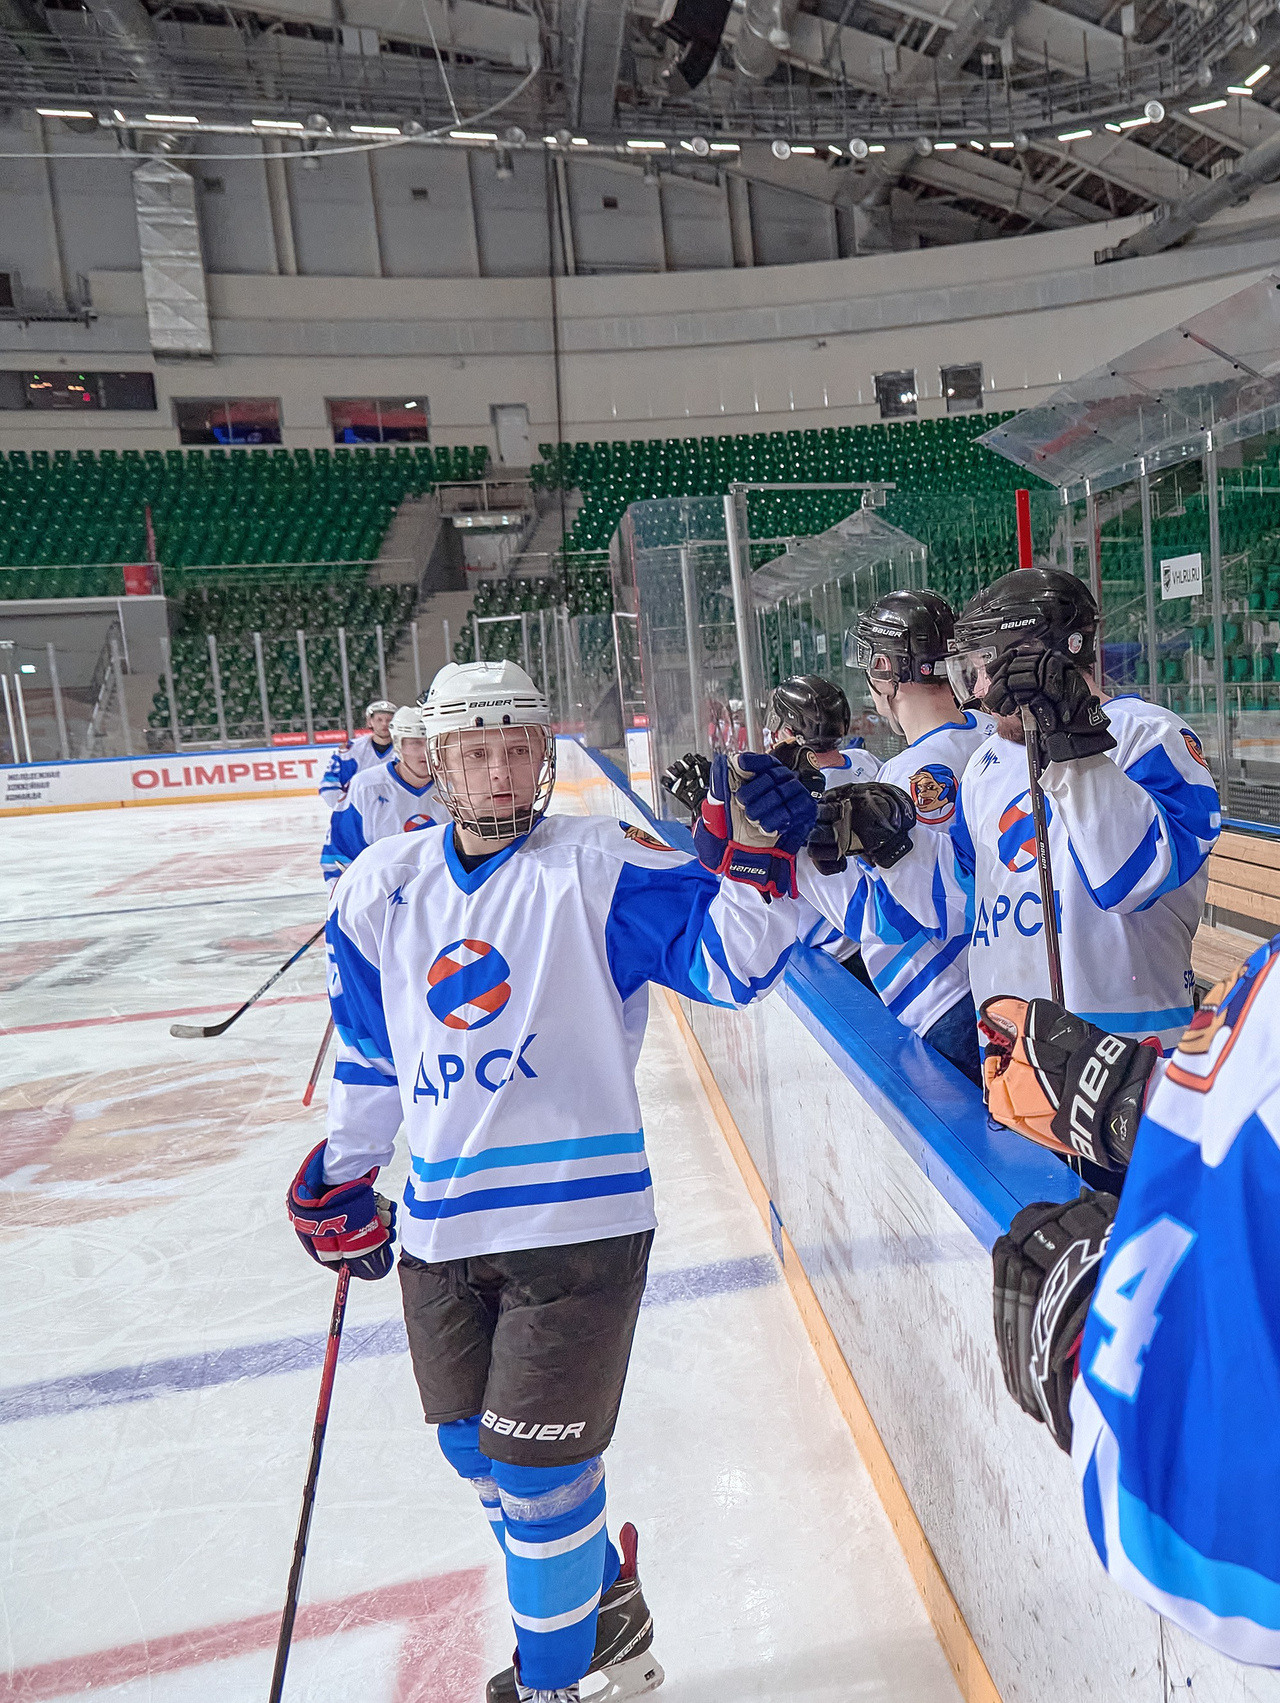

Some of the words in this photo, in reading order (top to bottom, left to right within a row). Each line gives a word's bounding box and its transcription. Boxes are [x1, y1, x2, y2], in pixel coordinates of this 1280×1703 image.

[871, 626, 903, 638] BAUER
[1000, 617, 1036, 630] BAUER
[468, 699, 513, 709] BAUER
[132, 758, 318, 790] OLIMPBET
[413, 1033, 539, 1107] ДРСК
[480, 1408, 587, 1441] BAUER
